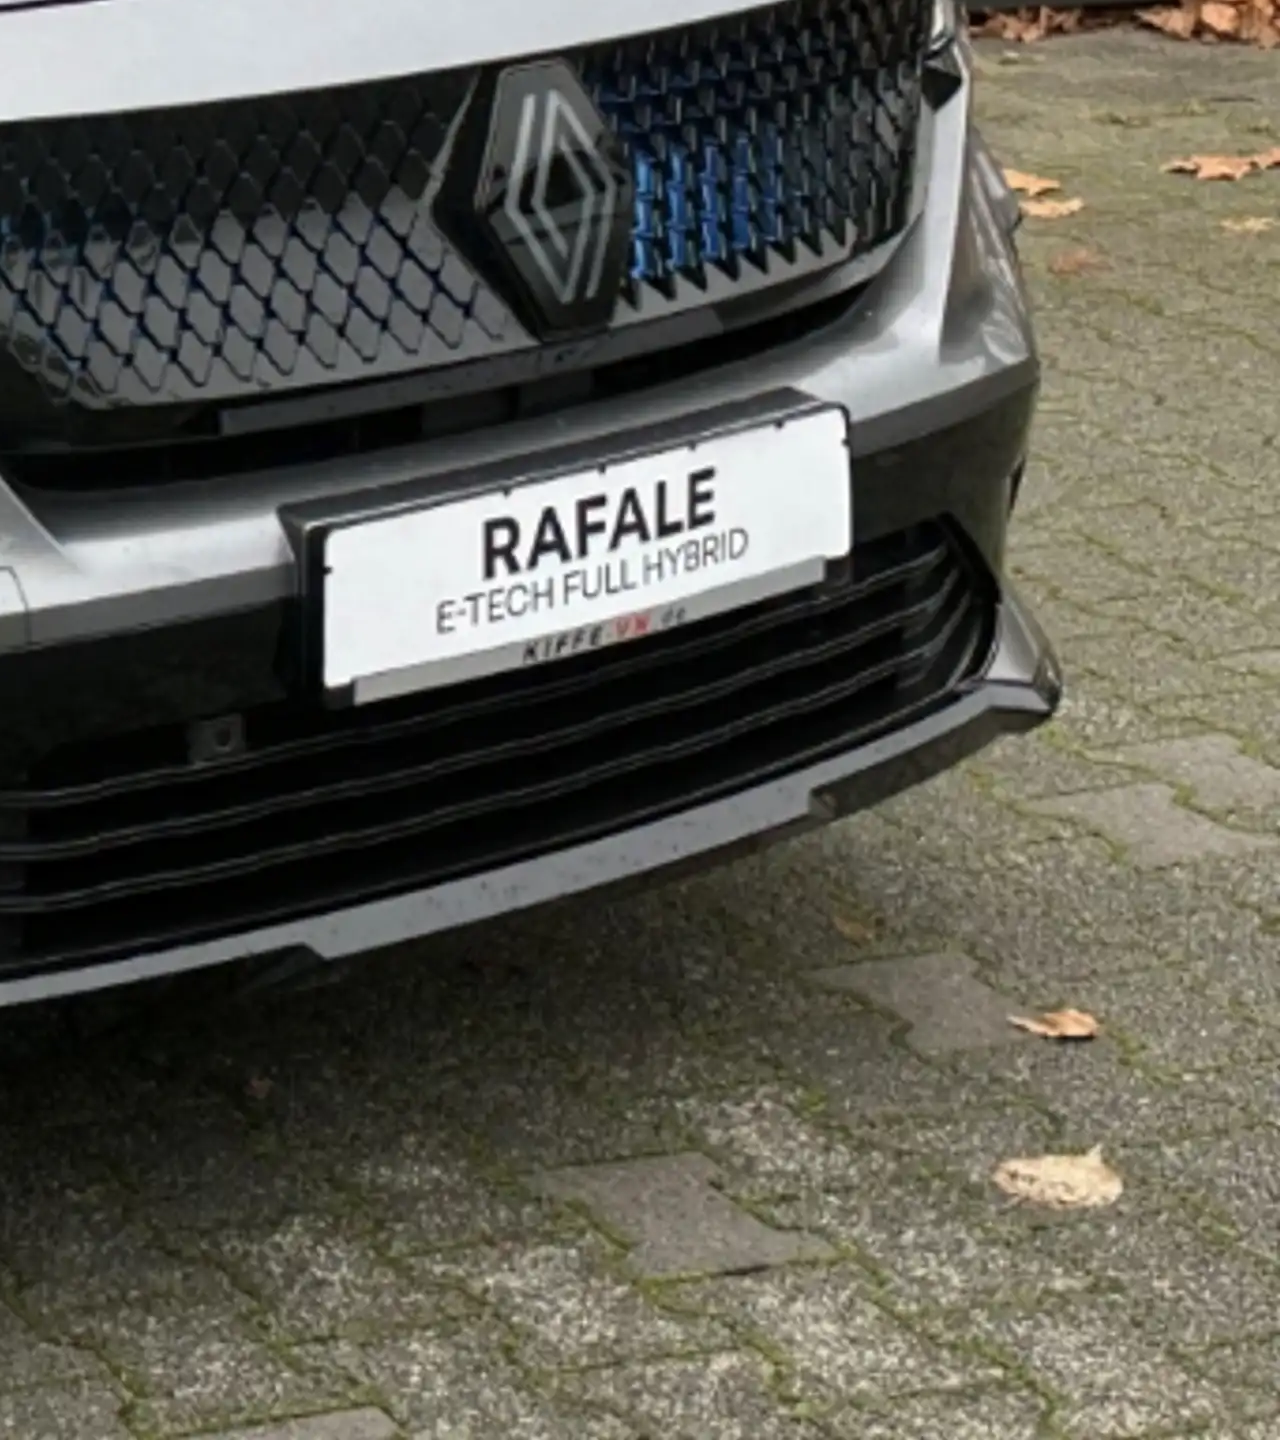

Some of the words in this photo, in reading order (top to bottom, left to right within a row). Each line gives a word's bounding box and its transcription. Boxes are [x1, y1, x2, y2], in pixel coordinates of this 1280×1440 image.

[482, 467, 717, 581] RAFALE
[436, 577, 555, 635] E-TECH
[563, 558, 637, 606] FULL
[643, 528, 749, 586] HYBRID
